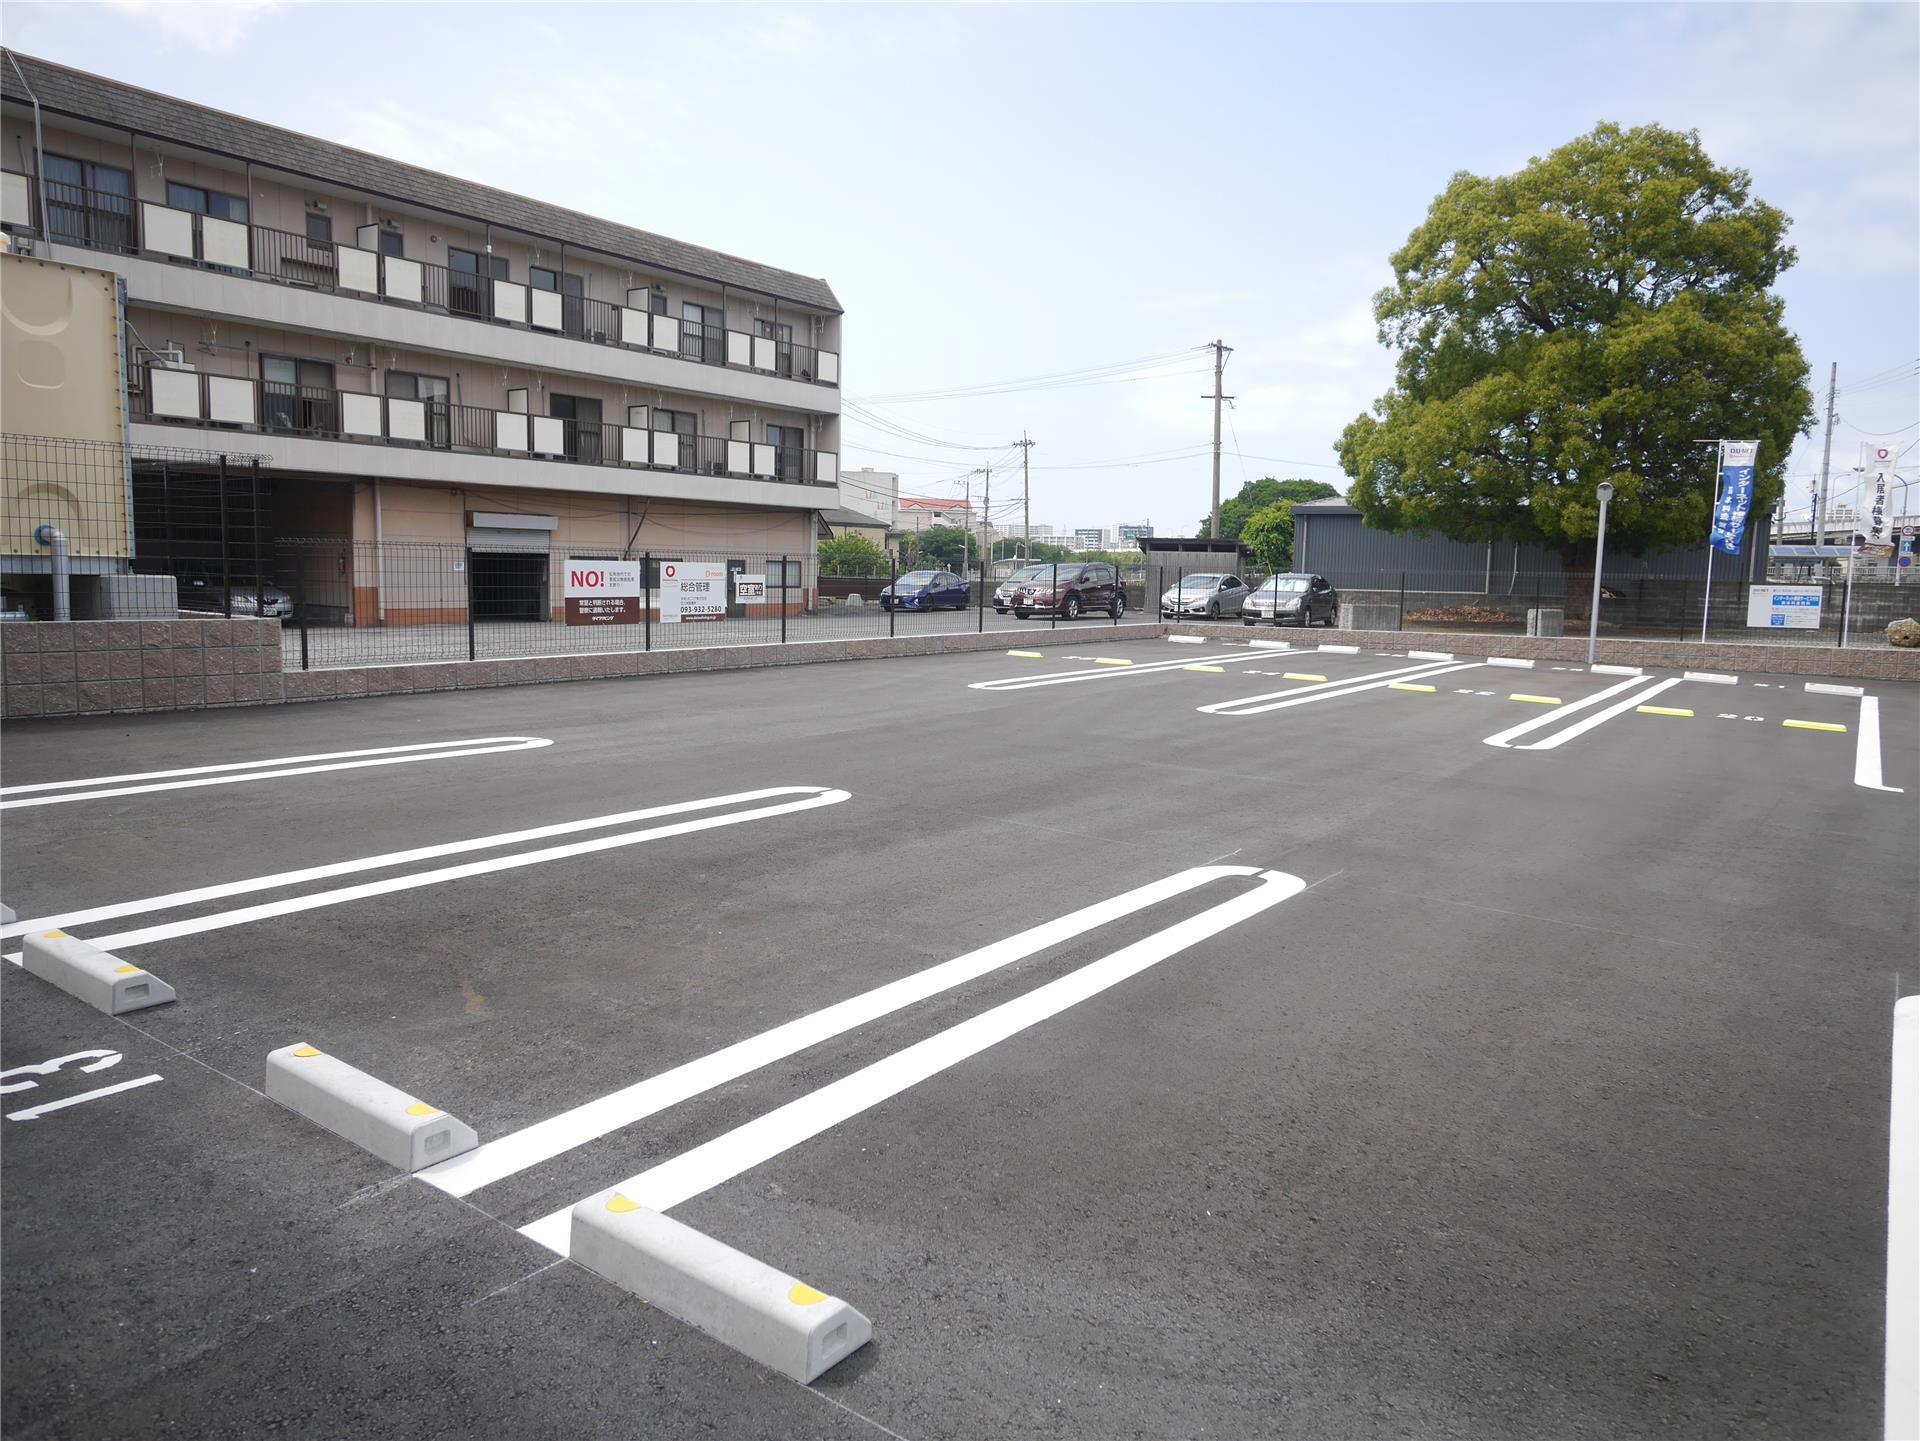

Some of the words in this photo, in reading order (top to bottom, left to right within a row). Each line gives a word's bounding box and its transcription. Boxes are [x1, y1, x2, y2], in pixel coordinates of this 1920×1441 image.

[571, 570, 605, 588] NO!
[680, 582, 710, 592] 総合管理
[680, 605, 722, 613] 093-932-5280
